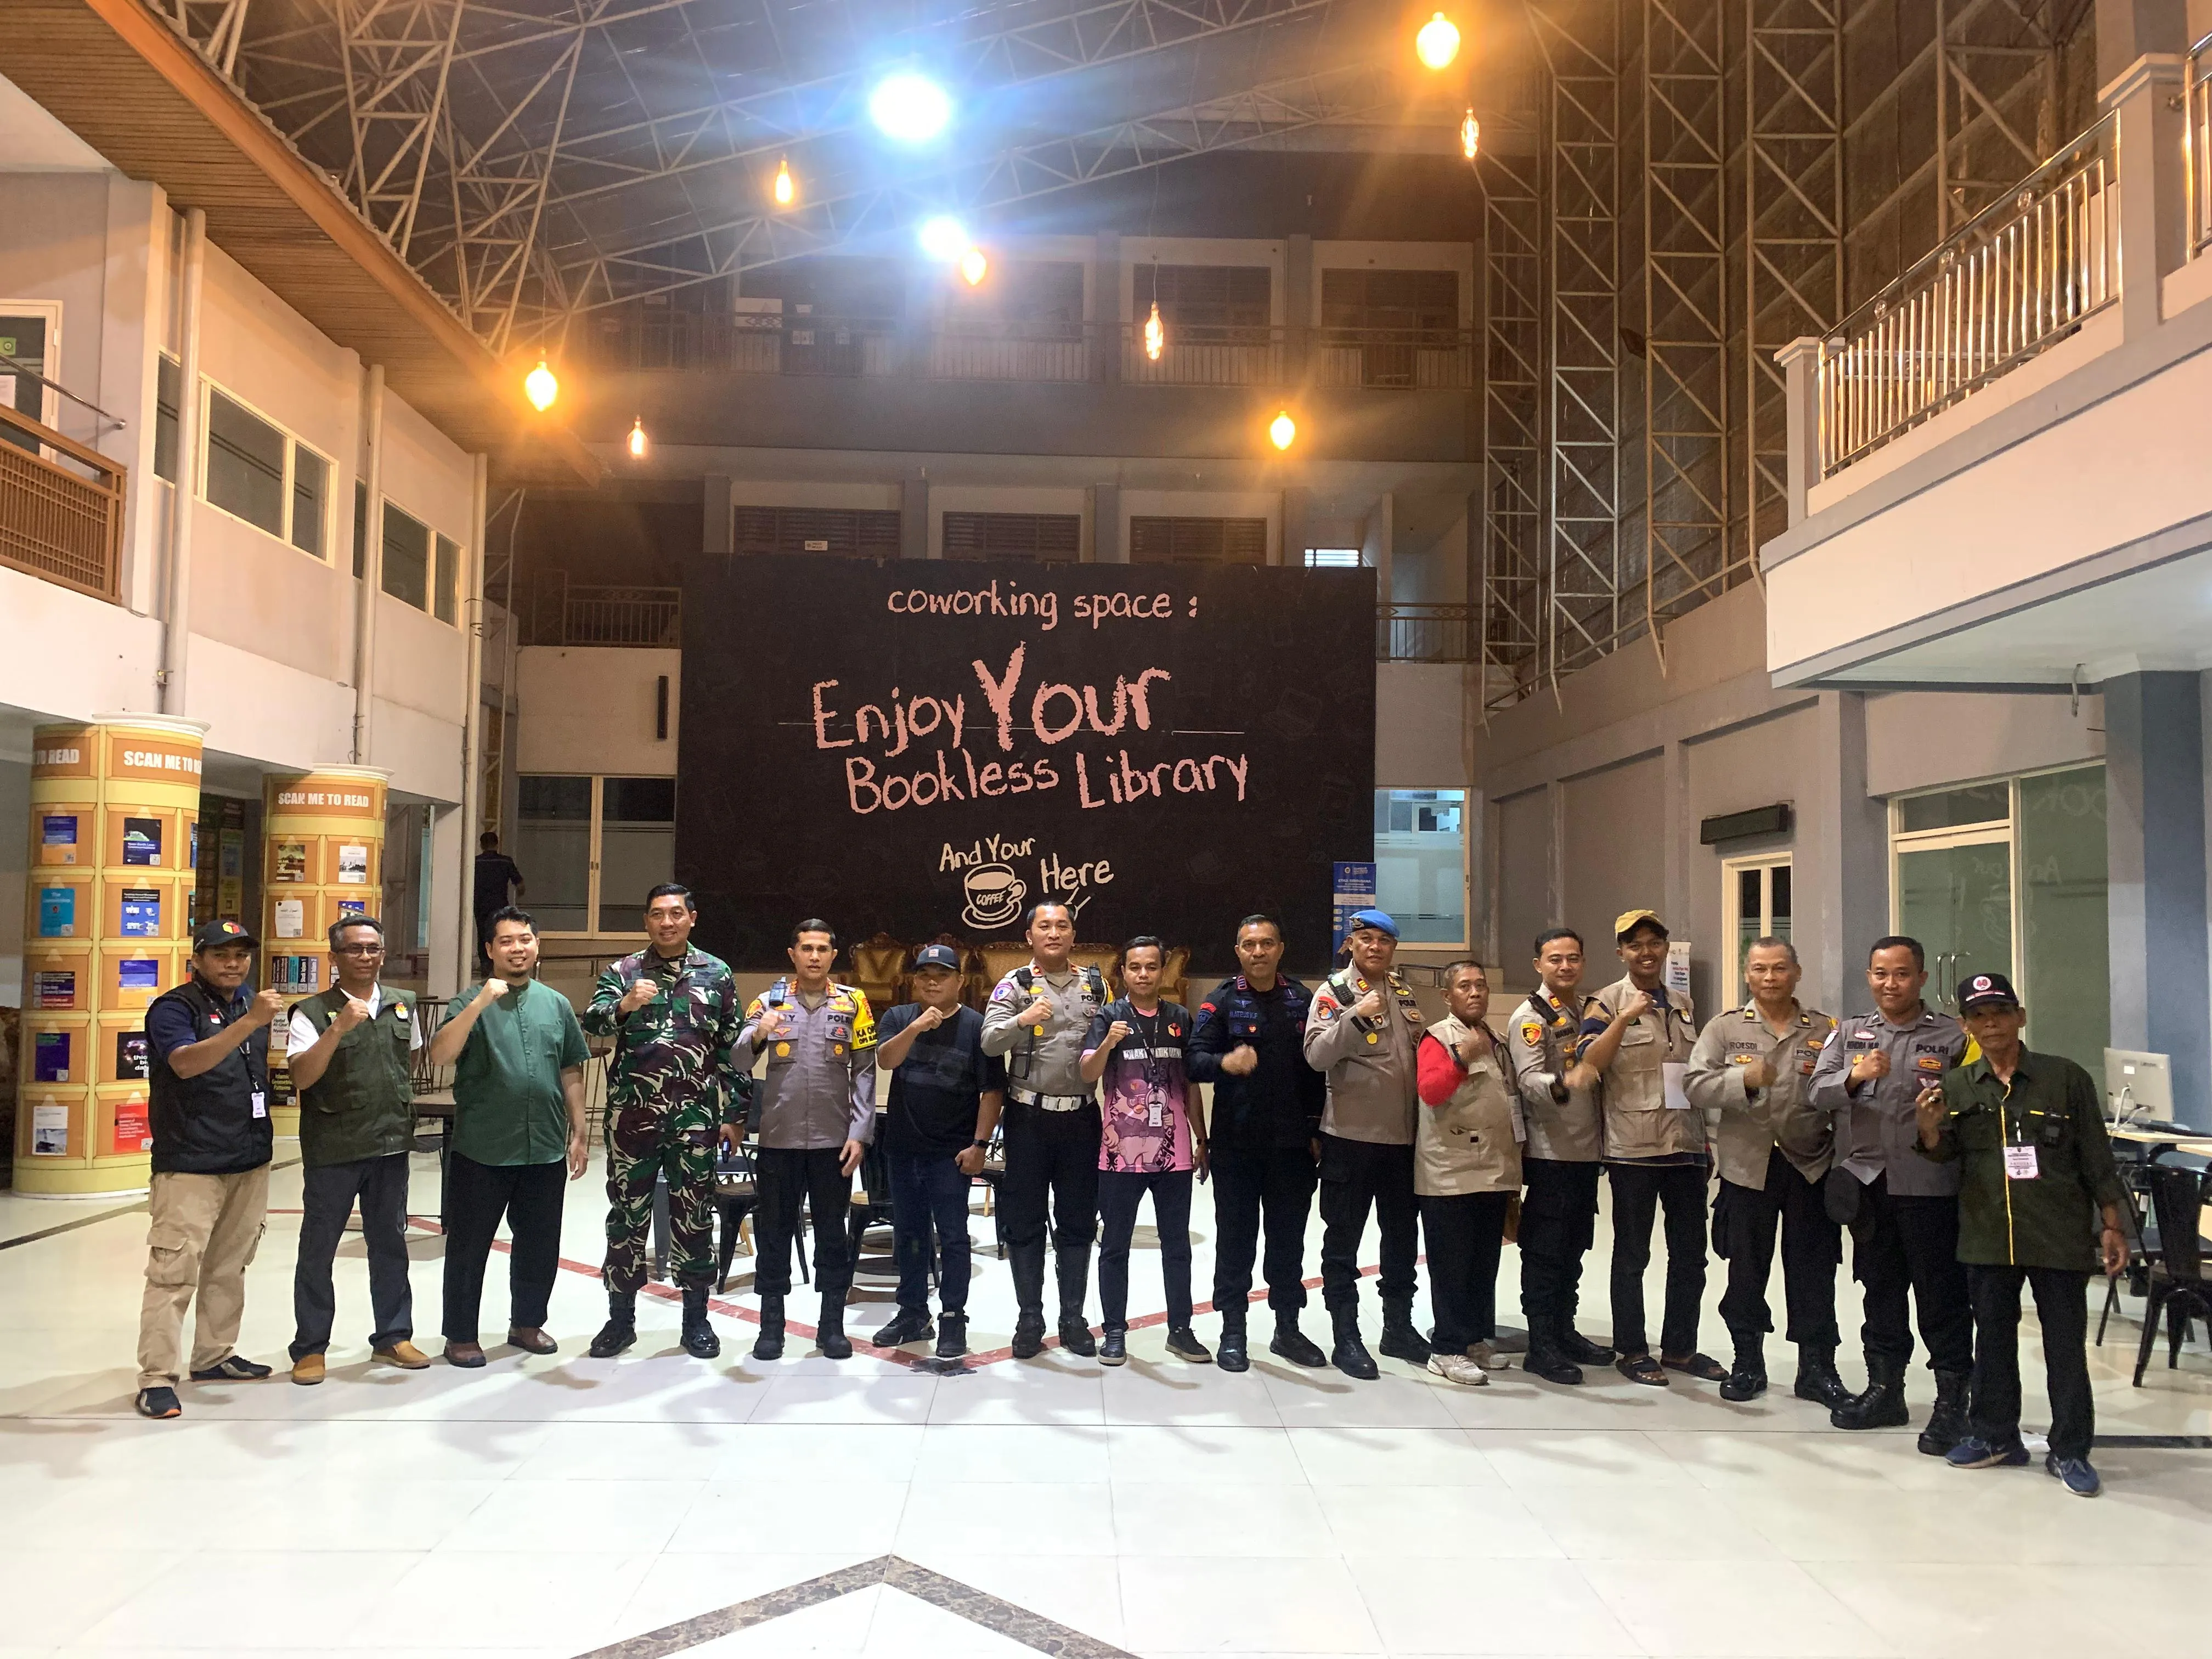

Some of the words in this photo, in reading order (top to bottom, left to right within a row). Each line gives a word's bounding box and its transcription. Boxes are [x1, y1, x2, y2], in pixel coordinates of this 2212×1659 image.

[888, 580, 1058, 630] coworking
[1074, 592, 1172, 629] space
[812, 680, 965, 757] Enjoy
[972, 641, 1171, 751] Your
[48, 749, 80, 764] READ
[123, 751, 162, 768] SCAN
[165, 754, 181, 770] ME
[182, 757, 193, 772] TO
[846, 749, 1059, 814] Bookless
[1076, 749, 1248, 809] Library
[278, 793, 305, 805] SCAN
[307, 793, 324, 805] ME
[326, 794, 342, 805] TO
[344, 794, 369, 808] READ
[939, 840, 982, 872] And
[985, 833, 1036, 862] Your
[1040, 853, 1114, 894] Here
[976, 890, 1007, 906] COFFEE
[856, 1028, 866, 1038] KA
[1915, 1043, 1949, 1054] POLRI
